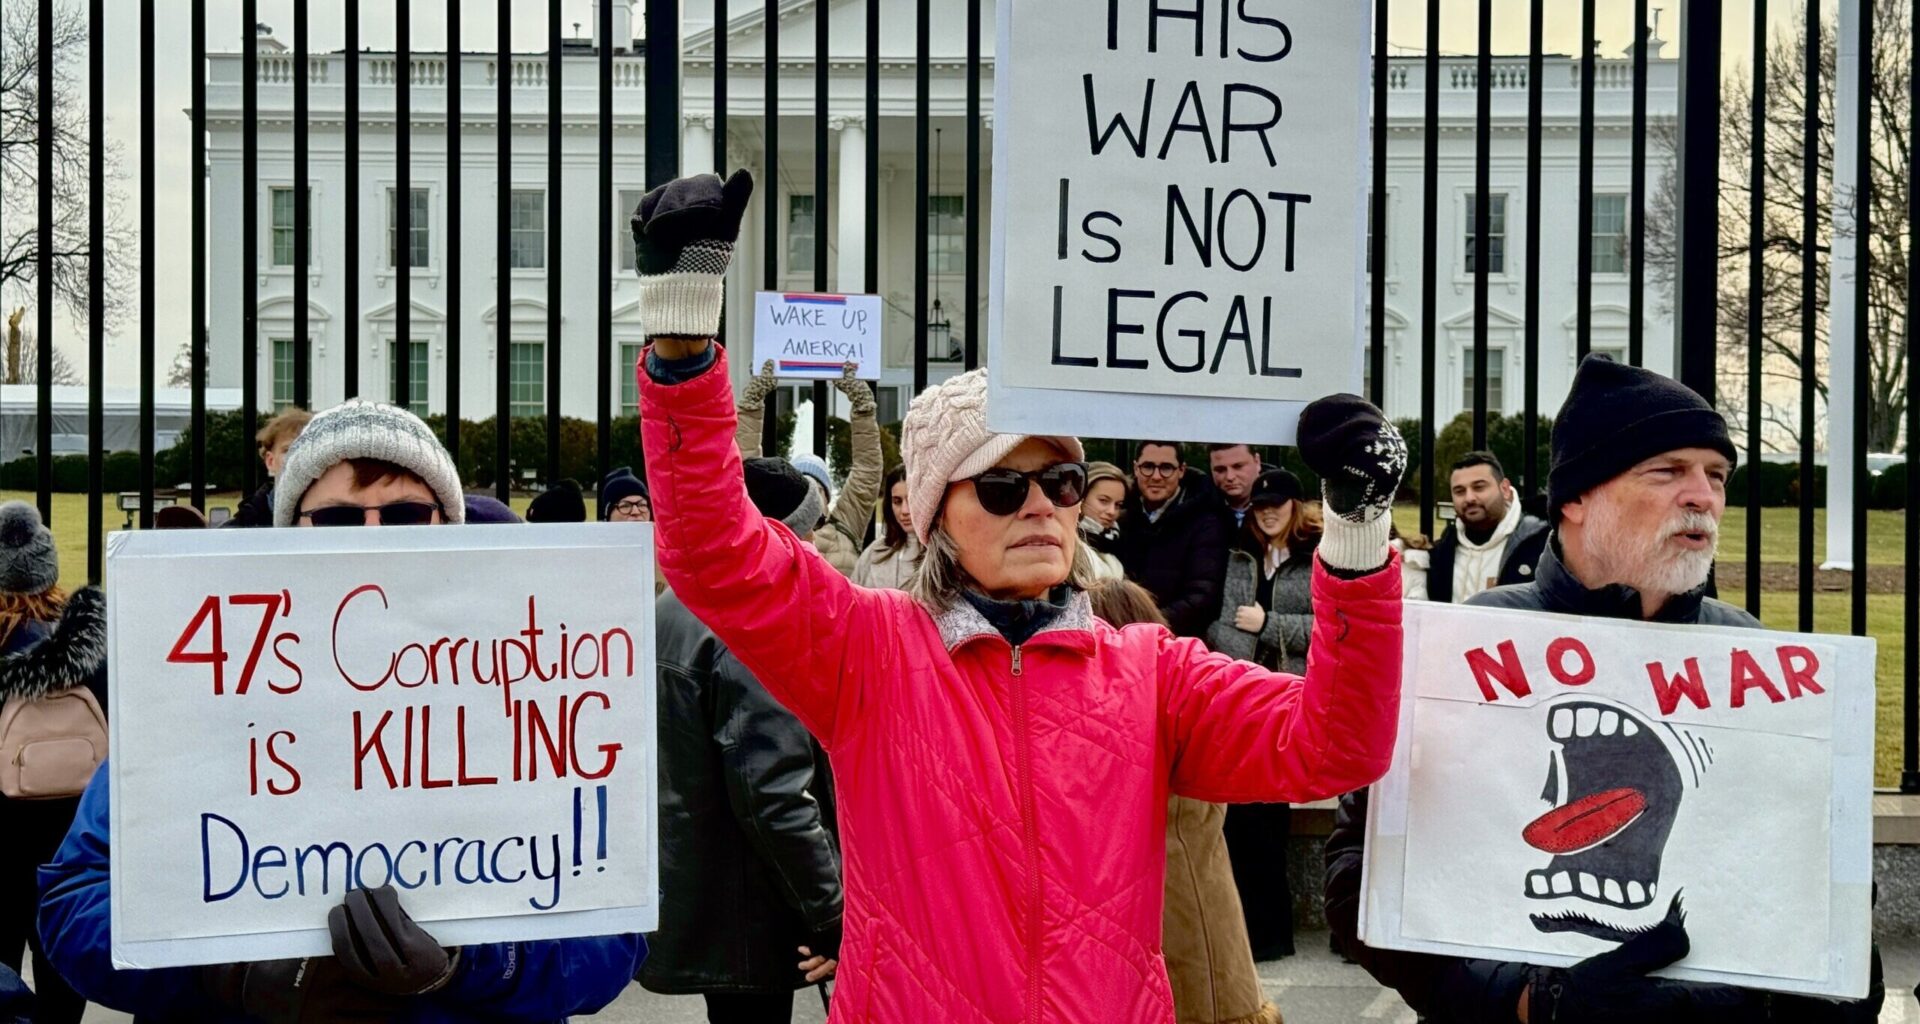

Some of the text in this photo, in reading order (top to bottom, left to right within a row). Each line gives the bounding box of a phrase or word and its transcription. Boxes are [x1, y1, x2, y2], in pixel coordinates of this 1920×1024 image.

[1082, 74, 1284, 167] WAR
[1057, 178, 1312, 272] Is NOT
[770, 304, 868, 336] WAKE UP,
[783, 338, 864, 362] AMERICA!
[1052, 285, 1303, 378] LEGAL
[166, 584, 634, 718] 47's Corruption
[1464, 636, 1825, 716] NO WAR
[247, 690, 623, 796] is KILLING
[200, 784, 608, 910] Democracy!!
